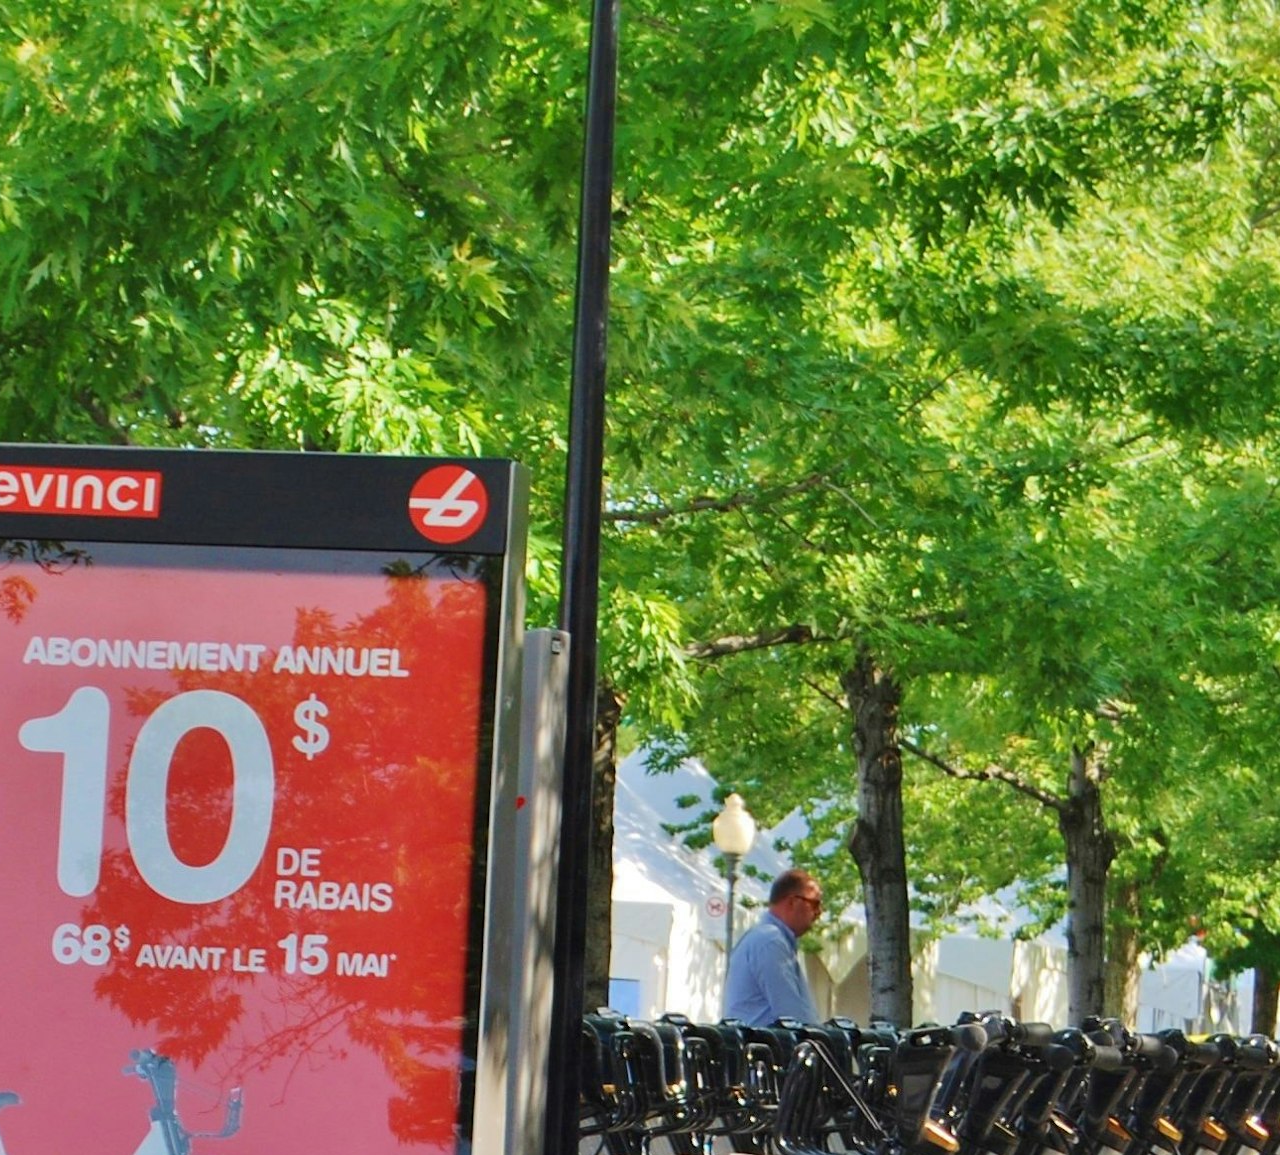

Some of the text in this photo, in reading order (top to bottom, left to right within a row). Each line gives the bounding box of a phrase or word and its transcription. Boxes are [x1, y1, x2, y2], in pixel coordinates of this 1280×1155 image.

[23, 635, 410, 678] ABONNEMENT ANNUEL
[277, 847, 322, 878] DE
[274, 880, 393, 913] RABAIS
[136, 944, 225, 972] AVANT
[233, 948, 266, 973] LE
[278, 933, 329, 976] 15
